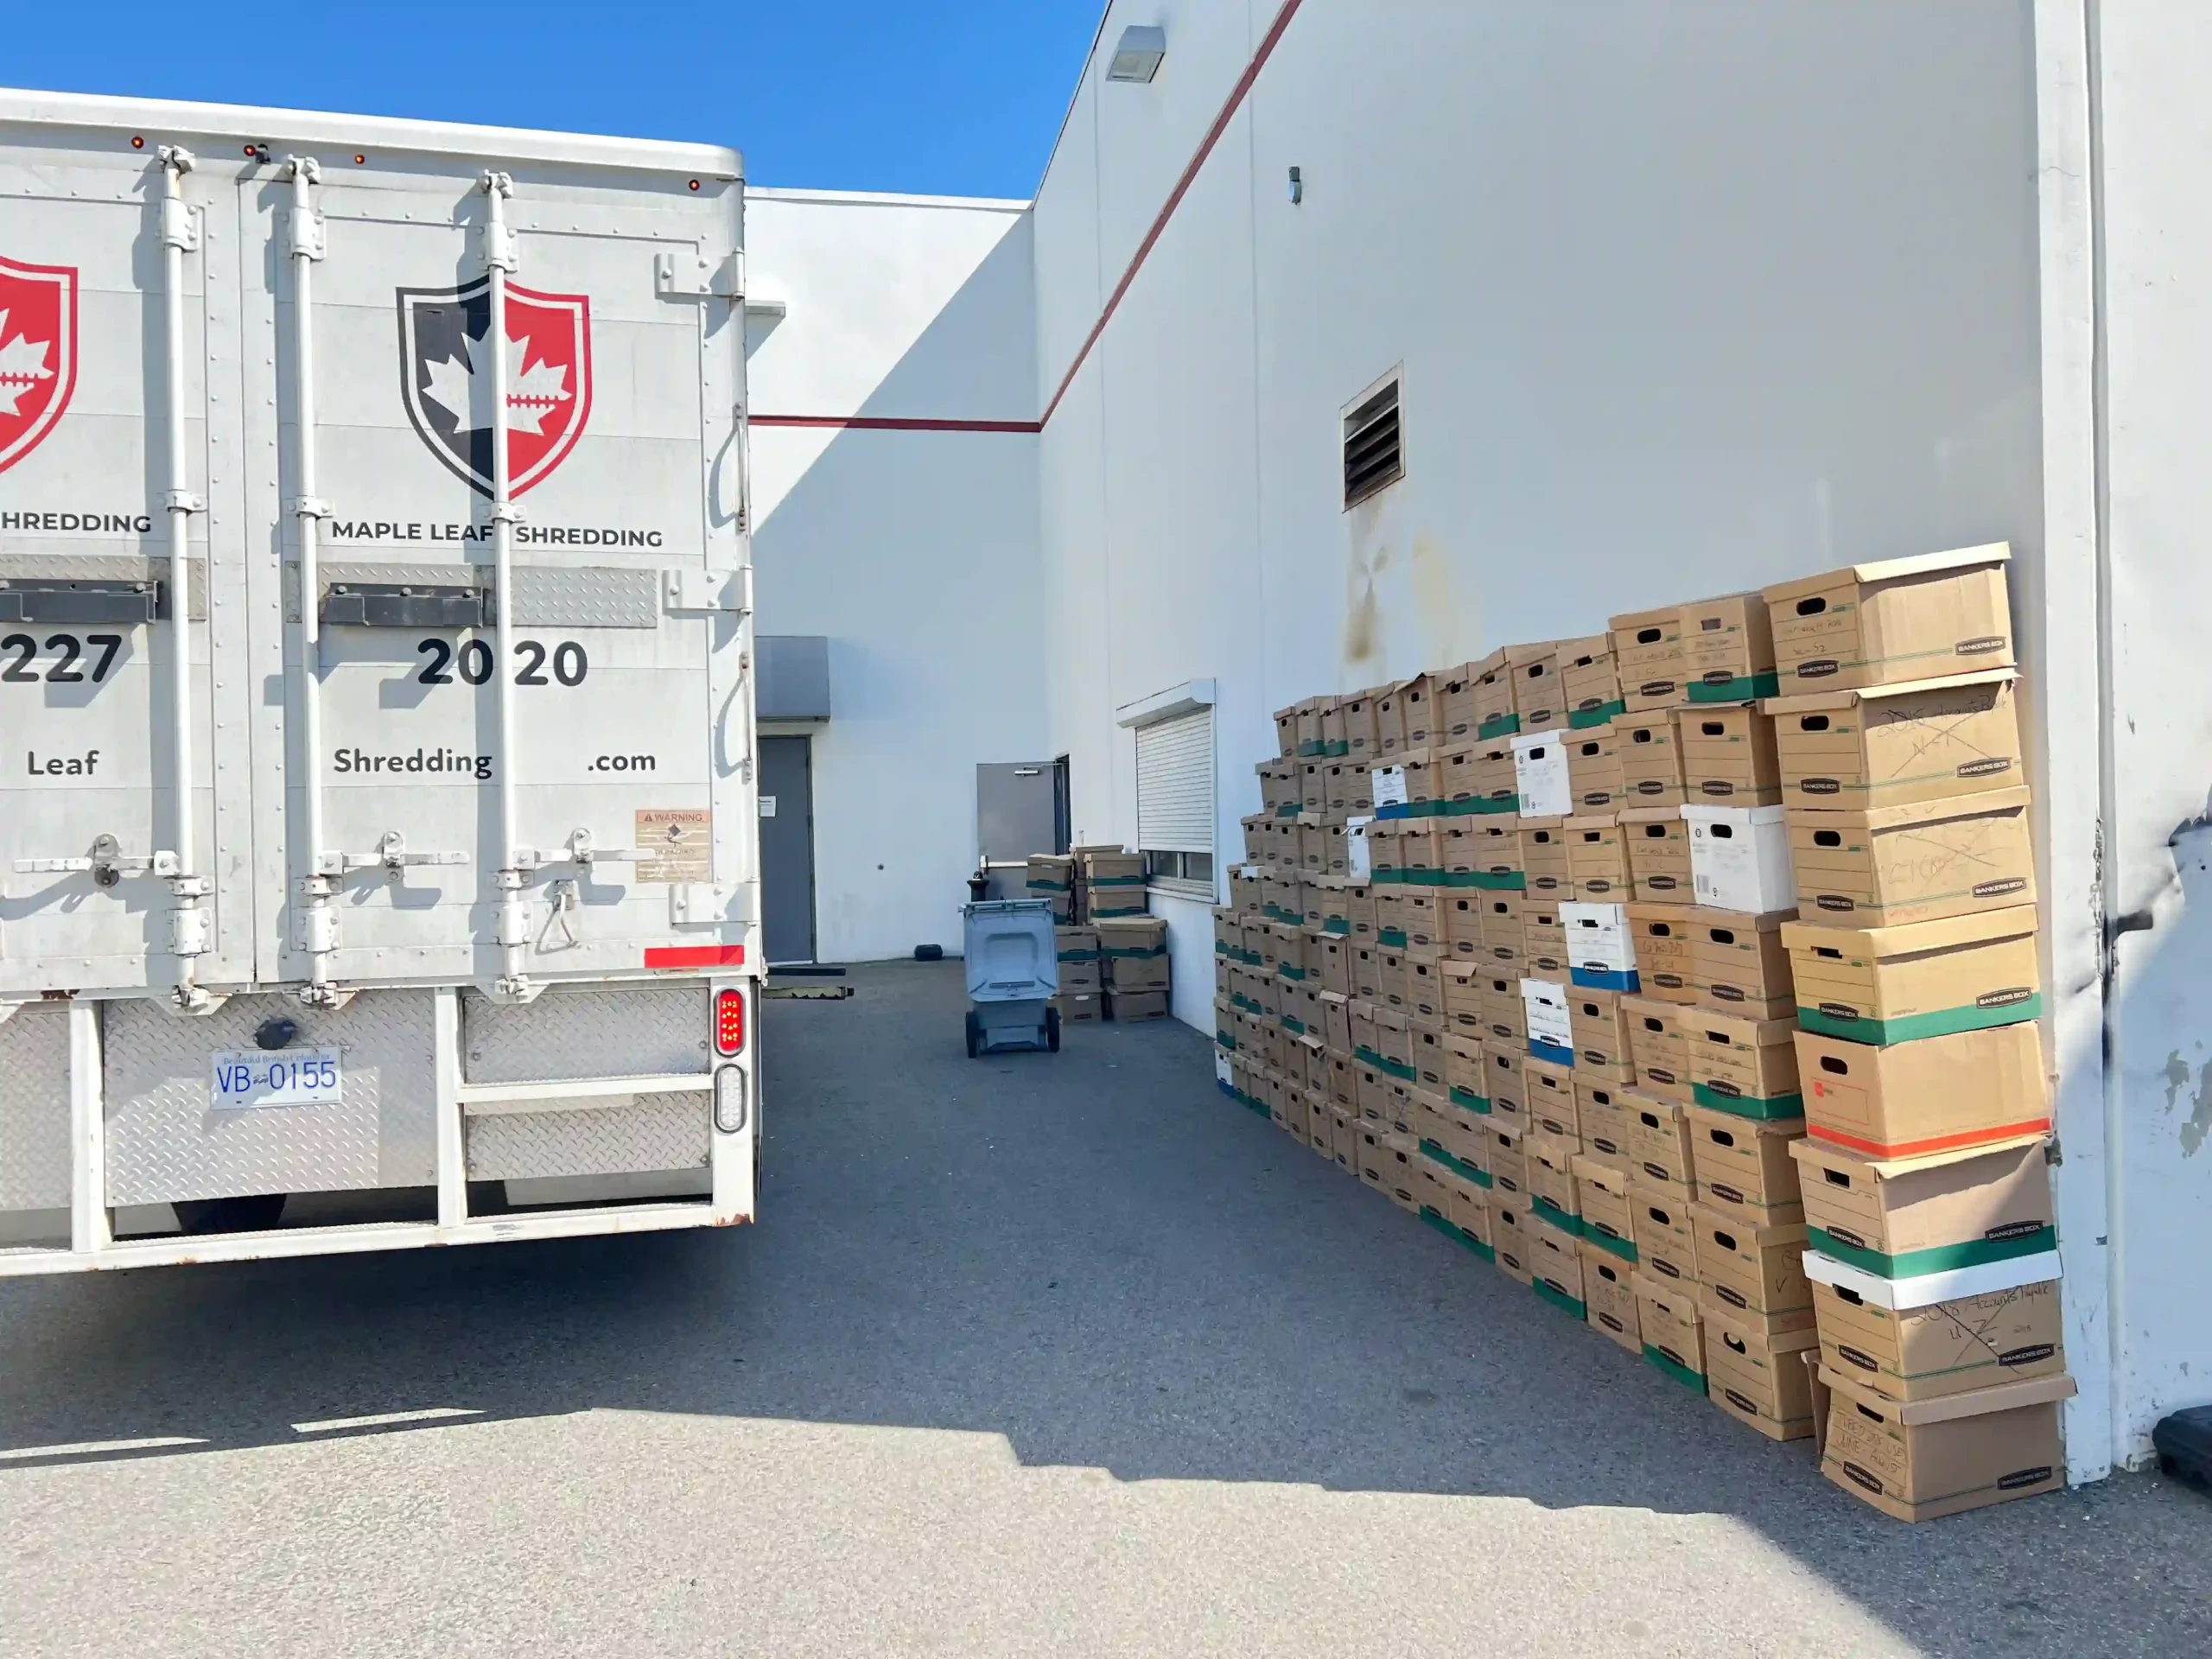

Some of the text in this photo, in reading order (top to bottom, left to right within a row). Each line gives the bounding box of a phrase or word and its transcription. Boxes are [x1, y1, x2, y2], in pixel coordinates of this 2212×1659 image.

[2, 512, 151, 533] HREDDING
[332, 521, 663, 547] MAPLE LEAF SHREDDING
[1, 633, 122, 683] 227
[28, 748, 656, 779] Leaf Shredding .com
[1961, 760, 2008, 774] BANKERS BOX
[654, 813, 702, 822] WARNING
[1975, 880, 2024, 894] BANKERS BOX
[1980, 990, 2029, 1006] BANKERS BOX
[1988, 1224, 2040, 1239] BANKERS BOX
[2036, 1347, 2051, 1357] BOX
